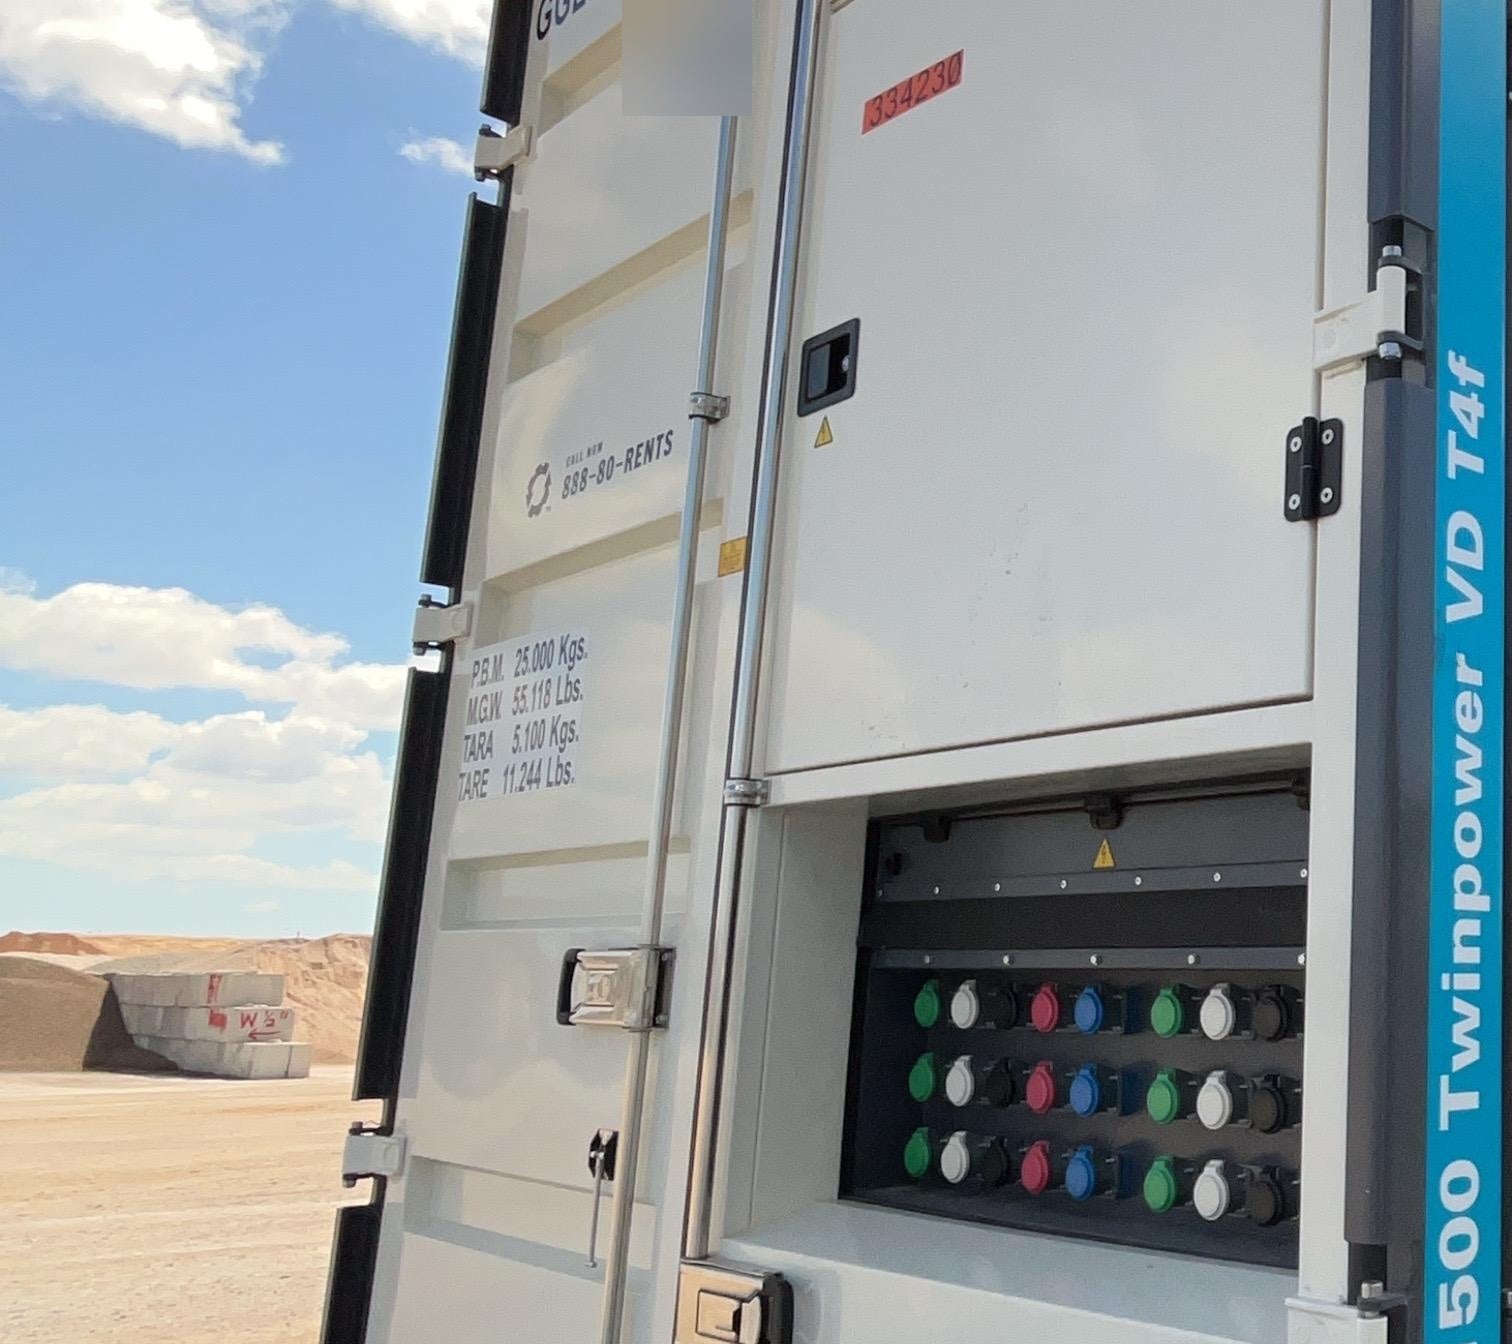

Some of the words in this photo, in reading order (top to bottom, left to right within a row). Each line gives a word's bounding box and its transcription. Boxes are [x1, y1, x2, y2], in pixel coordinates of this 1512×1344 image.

[868, 51, 962, 128] 334230
[1447, 349, 1486, 481] T4f
[561, 429, 674, 500] 888-80-RENTS
[1445, 509, 1485, 624] VD
[471, 653, 505, 689] P.B.M.
[513, 639, 556, 678] 25.000
[557, 633, 588, 672] Kgs.
[511, 678, 553, 716] 55.118
[555, 674, 584, 706] Lbs.
[463, 729, 495, 764] TARA
[511, 718, 546, 755] 5.100
[548, 714, 580, 754] Kgs.
[457, 768, 490, 802] TARE
[502, 757, 543, 795] 11.244
[545, 755, 576, 787] Lbs.
[1439, 652, 1491, 1131] Twinpower
